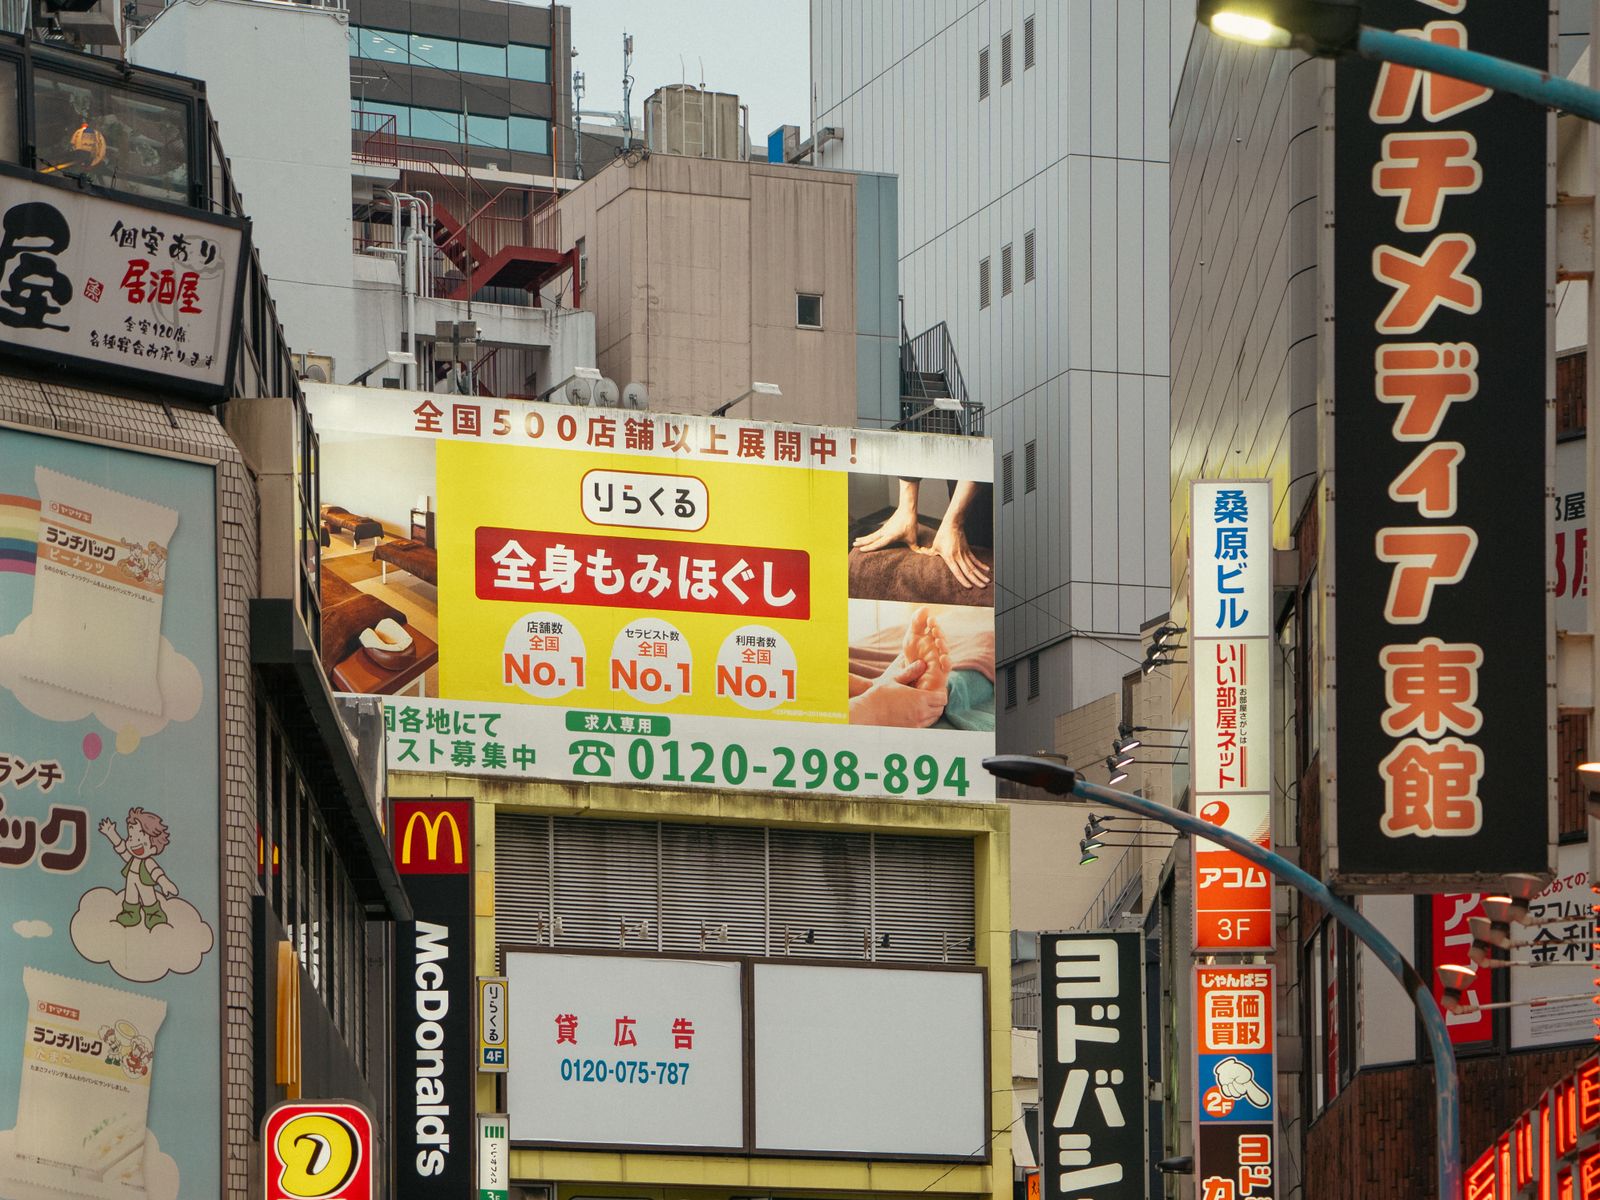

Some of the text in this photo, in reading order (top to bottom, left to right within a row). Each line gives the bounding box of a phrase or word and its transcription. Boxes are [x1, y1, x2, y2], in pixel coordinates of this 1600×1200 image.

[111, 221, 216, 264] 個室あり
[120, 259, 202, 313] 居酒屋
[1369, 0, 1484, 837] ルチメディア東館
[60, 505, 91, 523] ヤマザキ
[594, 482, 696, 519] りらくる
[46, 527, 116, 561] ランチパック
[50, 548, 105, 574] ピーナッツ
[491, 540, 797, 607] 全身もみほぐし
[1214, 490, 1249, 629] 桑原ビル
[527, 621, 563, 635] 店舗数
[625, 628, 680, 643] セラピスト数
[736, 635, 777, 649] 利用者数
[529, 635, 560, 651] 全国
[638, 642, 668, 657] 全国
[741, 649, 771, 665] 全国
[504, 654, 585, 687] No.1
[611, 659, 691, 693] No.1
[717, 666, 795, 699] No.1
[584, 714, 652, 733] 求人専用
[1216, 643, 1237, 789] いい部屋ネット
[385, 737, 536, 771] スト募集中
[628, 738, 970, 797] 0120-298-894
[0, 797, 88, 871] ック
[1199, 868, 1267, 888] アコム
[1217, 918, 1251, 940] 3F
[47, 1005, 79, 1020] ヤマザキ
[489, 987, 499, 1041] りらくる
[1210, 995, 1259, 1018] 高価
[33, 1026, 103, 1056] ランチパック
[1211, 1022, 1260, 1045] 買取
[415, 920, 449, 1177] McDonald's
[486, 1051, 502, 1062] 4F
[561, 1058, 690, 1085] 0120-075-787
[1207, 1091, 1232, 1114] 2F
